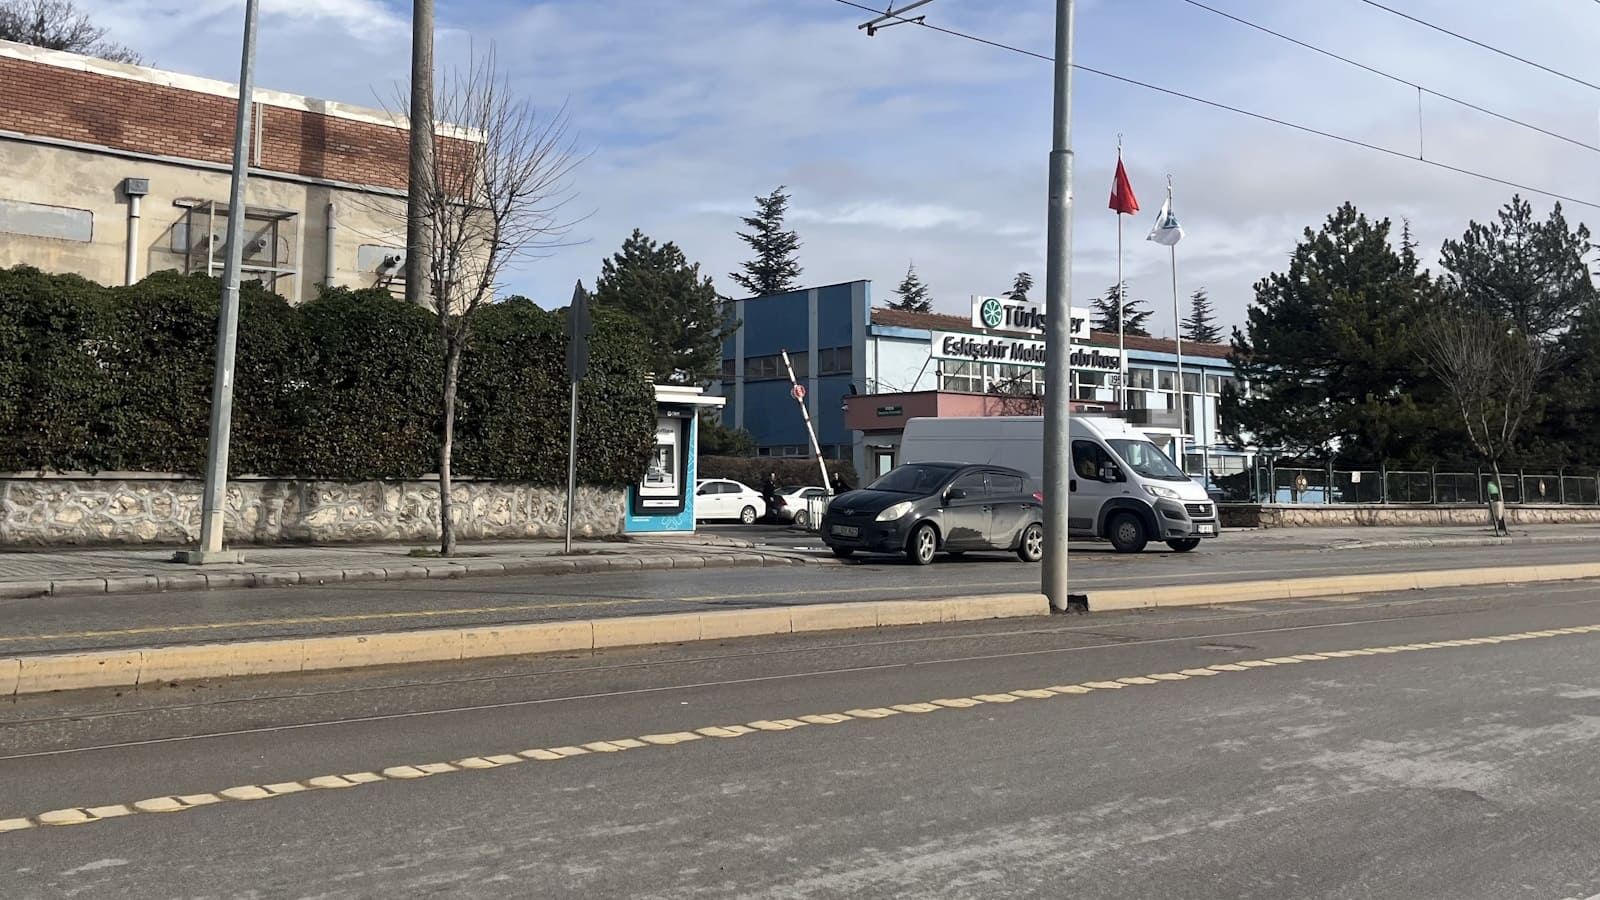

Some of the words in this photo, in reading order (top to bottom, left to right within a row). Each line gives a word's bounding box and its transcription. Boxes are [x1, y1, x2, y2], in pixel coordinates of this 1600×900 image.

[1003, 304, 1085, 334] Türkşer
[942, 336, 1009, 361] Eskişehir
[1069, 348, 1120, 369] abrikası
